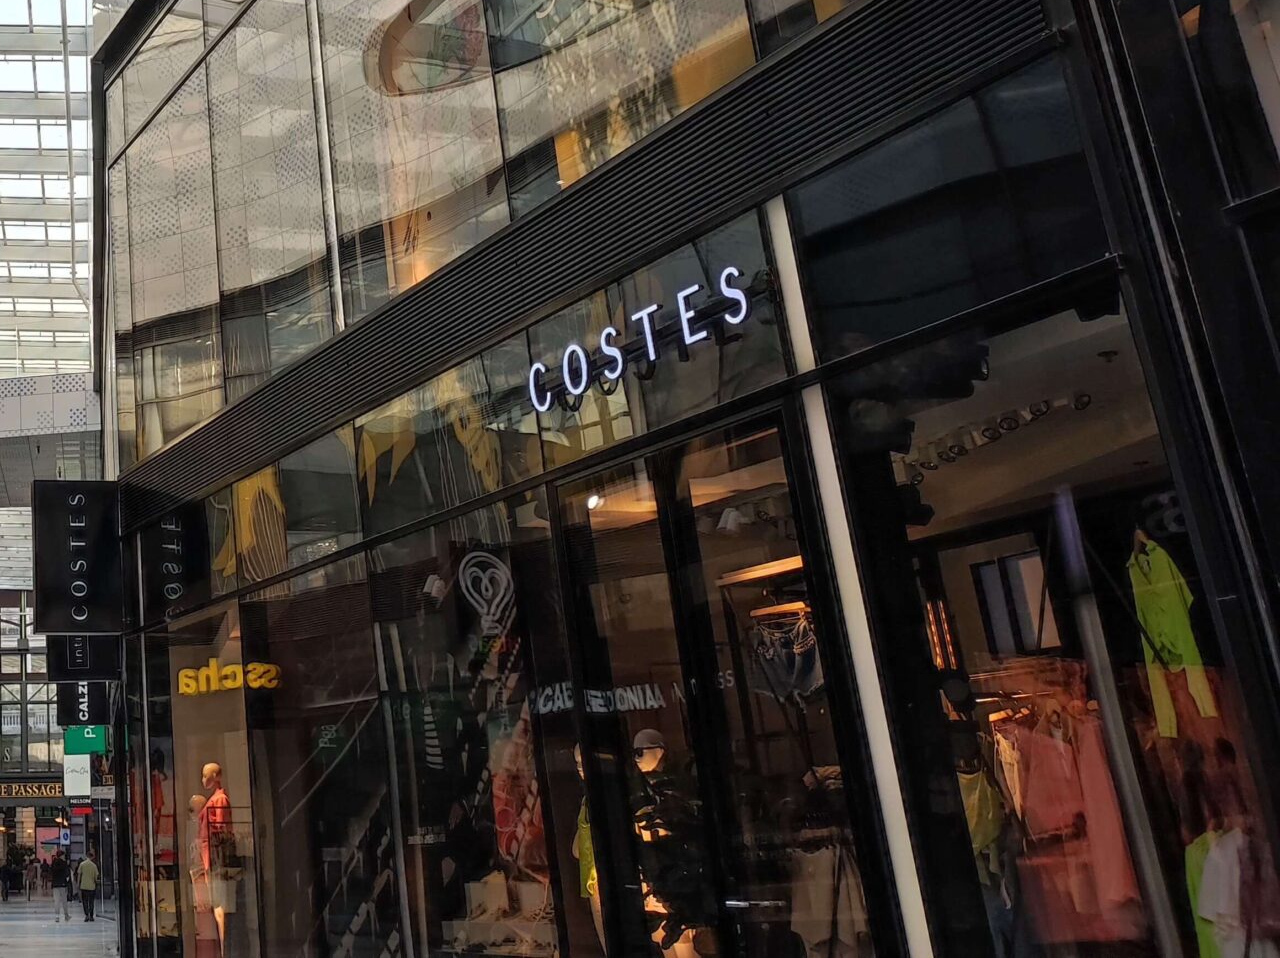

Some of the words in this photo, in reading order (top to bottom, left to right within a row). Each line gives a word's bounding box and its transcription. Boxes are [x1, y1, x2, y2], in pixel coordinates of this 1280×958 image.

[529, 267, 749, 412] COSTES
[69, 493, 88, 621] COSTES
[11, 783, 63, 796] PASSAGE
